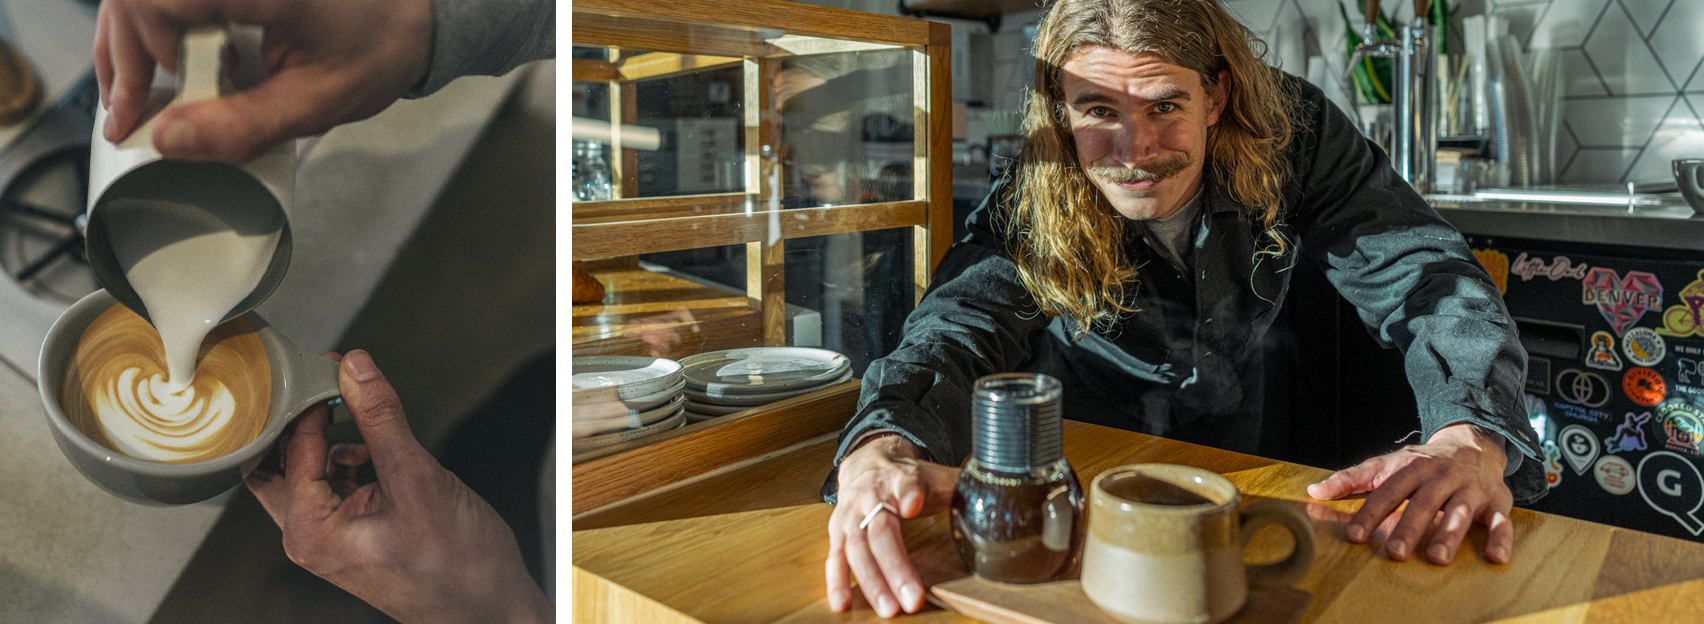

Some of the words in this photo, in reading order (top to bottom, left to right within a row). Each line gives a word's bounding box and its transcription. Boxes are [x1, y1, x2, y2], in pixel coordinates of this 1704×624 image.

[1584, 288, 1661, 310] DENVER
[1627, 369, 1664, 393] DIVISION
[1655, 402, 1693, 424] CROOKED
[1656, 468, 1682, 497] G
